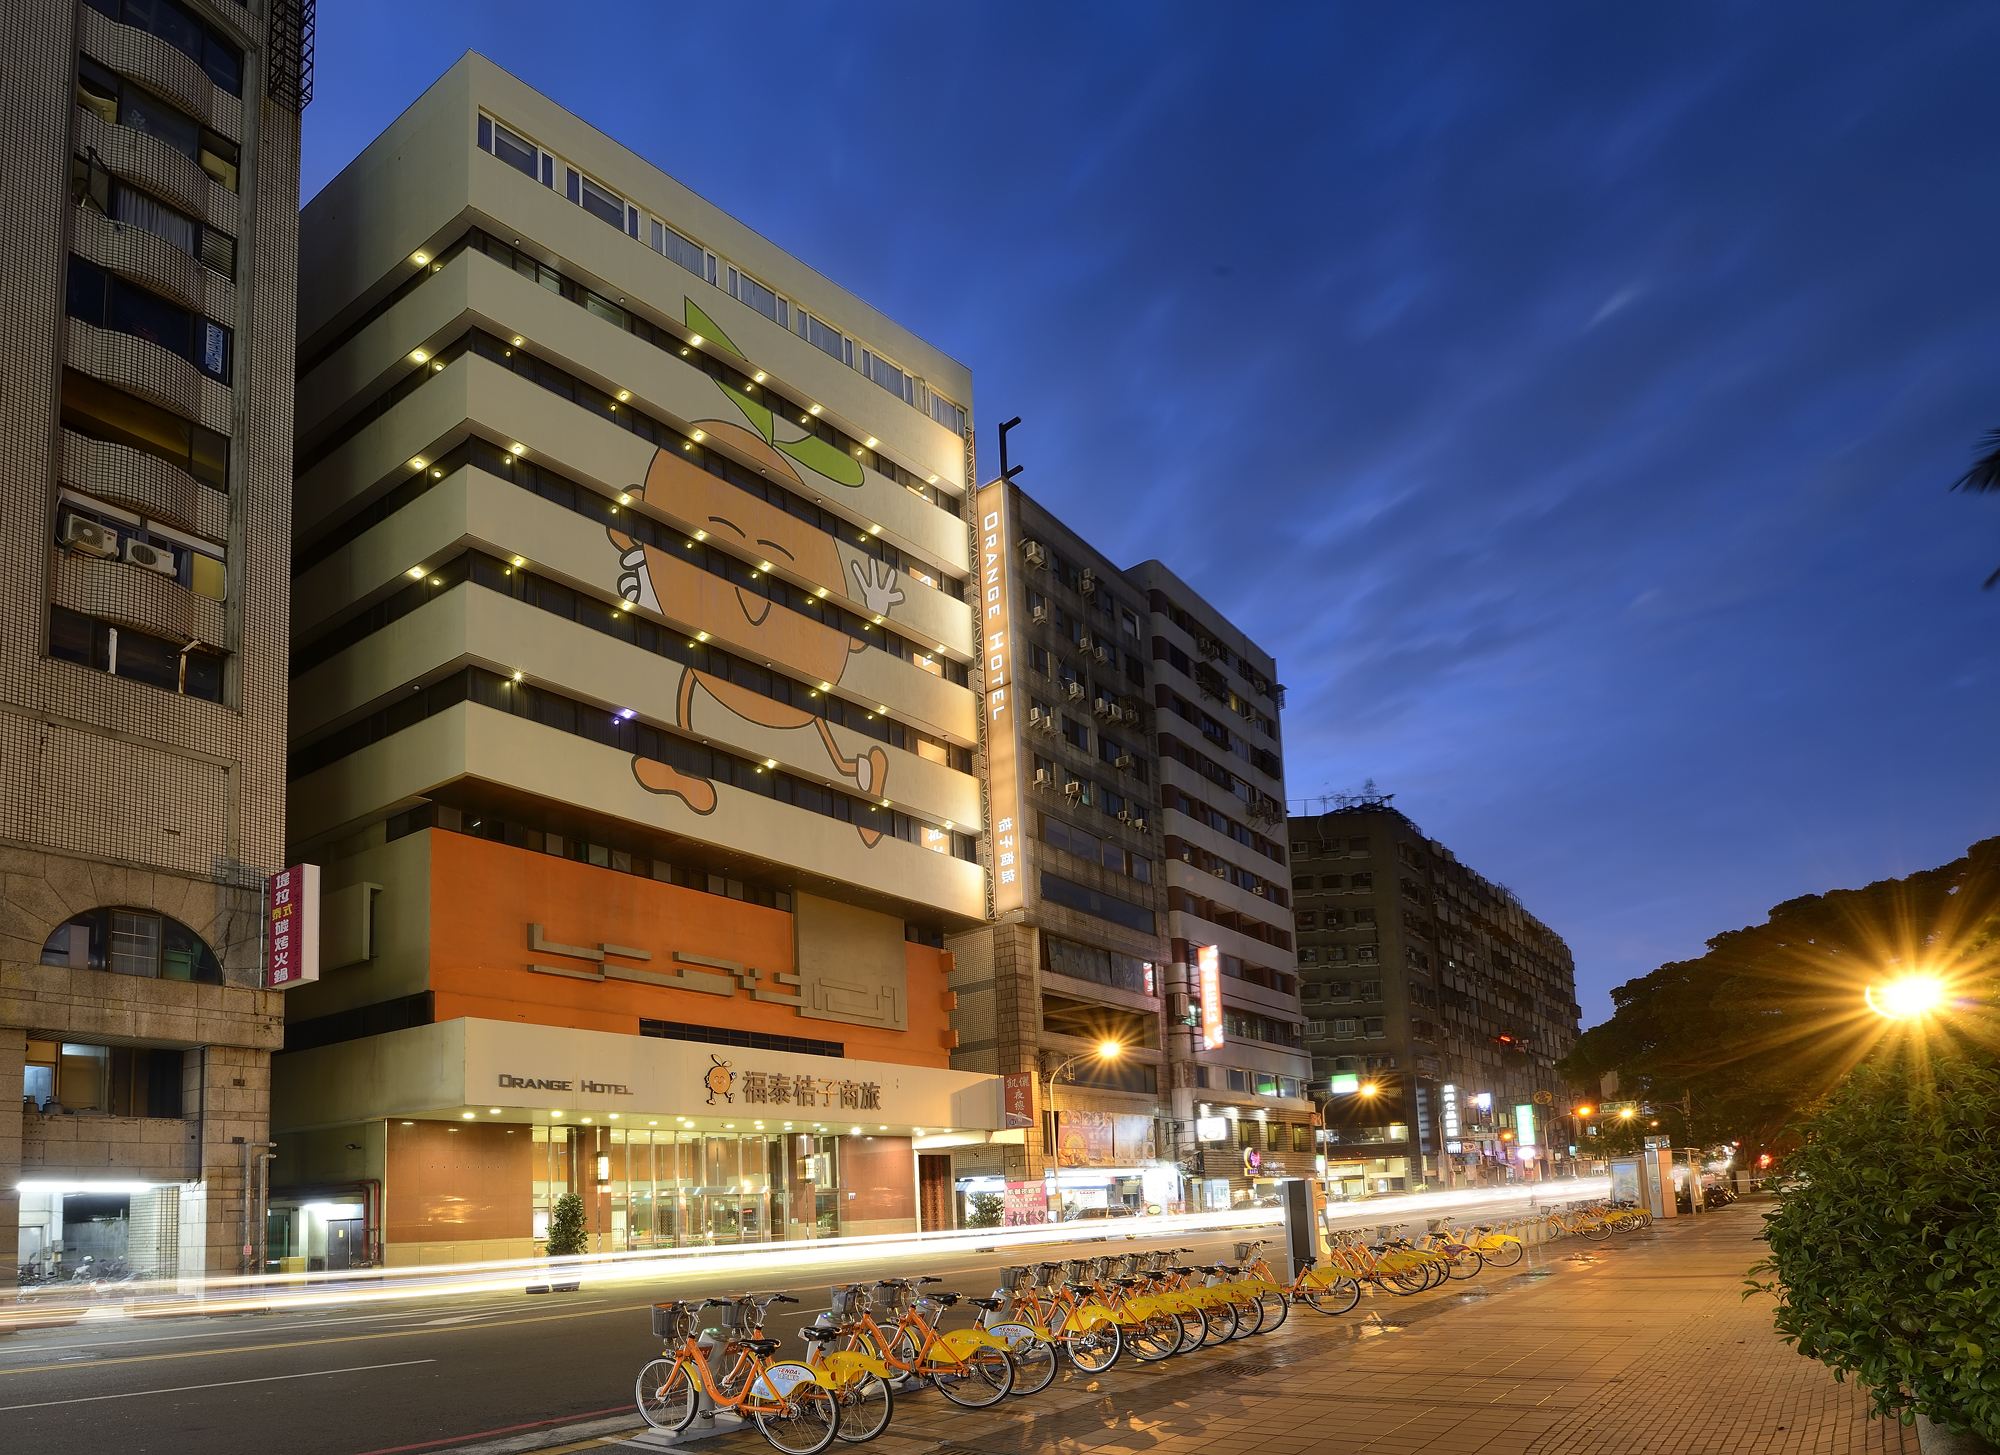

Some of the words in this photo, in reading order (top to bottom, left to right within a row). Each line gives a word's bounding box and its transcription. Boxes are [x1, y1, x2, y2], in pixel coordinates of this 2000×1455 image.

[984, 511, 1001, 620] ORANGE
[989, 631, 1005, 721] HOTEL
[998, 816, 1015, 884] 桔子商旅
[498, 1074, 573, 1091] ORANGE
[581, 1080, 634, 1095] HOTEL
[742, 1070, 882, 1111] 福泰桔子商旅
[776, 1367, 798, 1375] KENDA
